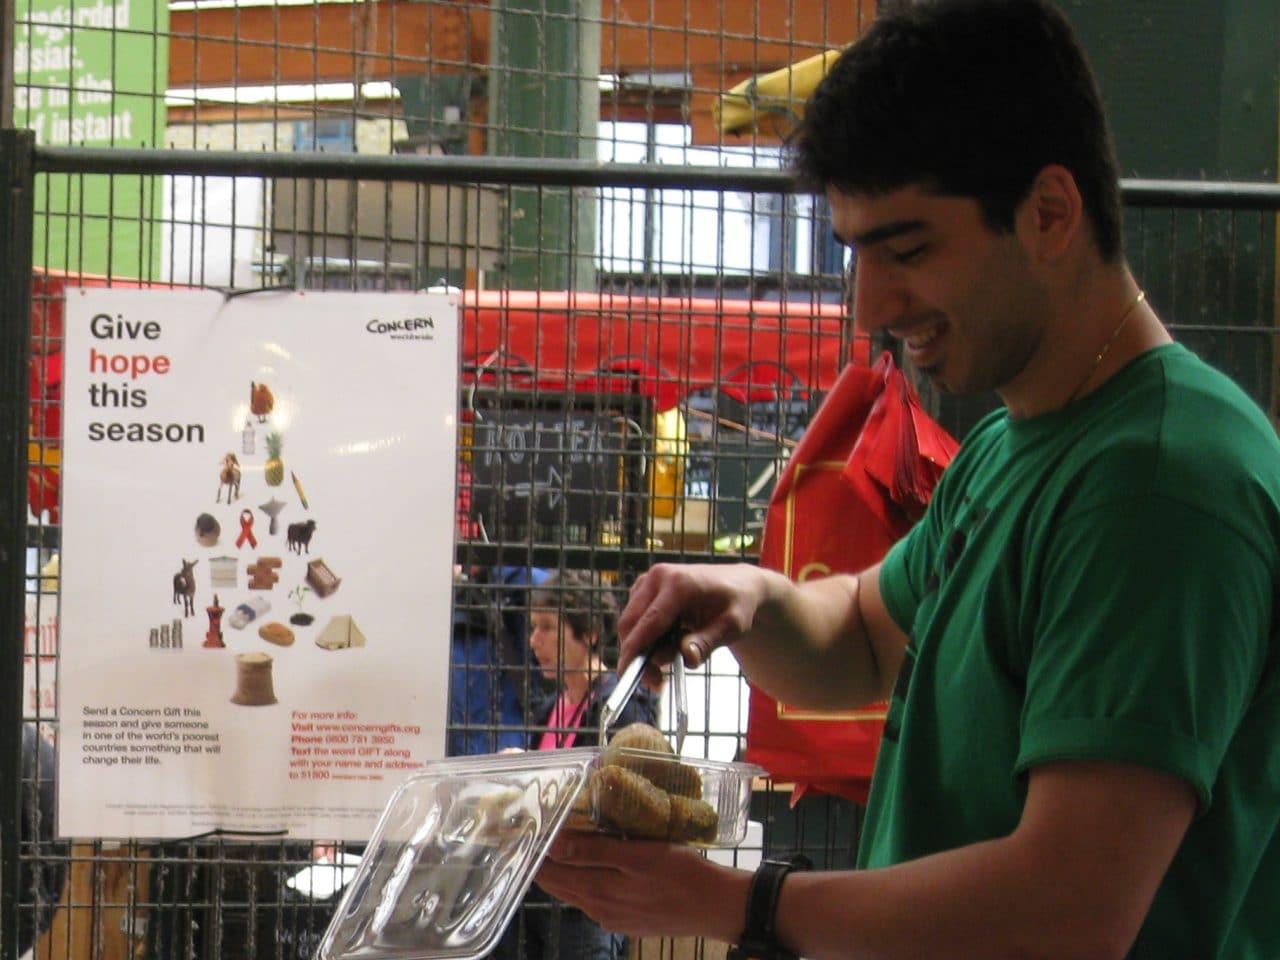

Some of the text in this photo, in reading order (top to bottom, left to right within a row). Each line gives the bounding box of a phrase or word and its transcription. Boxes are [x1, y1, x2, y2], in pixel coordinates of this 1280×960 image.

[51, 110, 132, 143] instant
[90, 314, 161, 340] Give
[89, 348, 171, 379] hope
[88, 382, 147, 408] this
[88, 422, 205, 442] season
[83, 707, 108, 716] Send
[120, 707, 161, 717] Concern
[164, 707, 181, 717] Gift
[184, 708, 201, 717] this
[292, 711, 307, 719] For
[120, 719, 139, 728] and
[142, 720, 162, 730] give
[164, 721, 209, 729] someone
[292, 723, 314, 731] Visit
[83, 732, 92, 740] in
[115, 732, 125, 740] of
[127, 732, 143, 740] the
[145, 732, 180, 741] world's
[182, 732, 219, 743] poorest
[291, 735, 323, 744] Phone
[83, 744, 221, 754] countries something that will
[291, 747, 411, 758] Text the word GIFT along
[83, 756, 162, 766] change their life.
[290, 759, 309, 767] with
[312, 760, 331, 769] your
[335, 760, 362, 768] name
[364, 760, 383, 768] and
[289, 771, 298, 779] to
